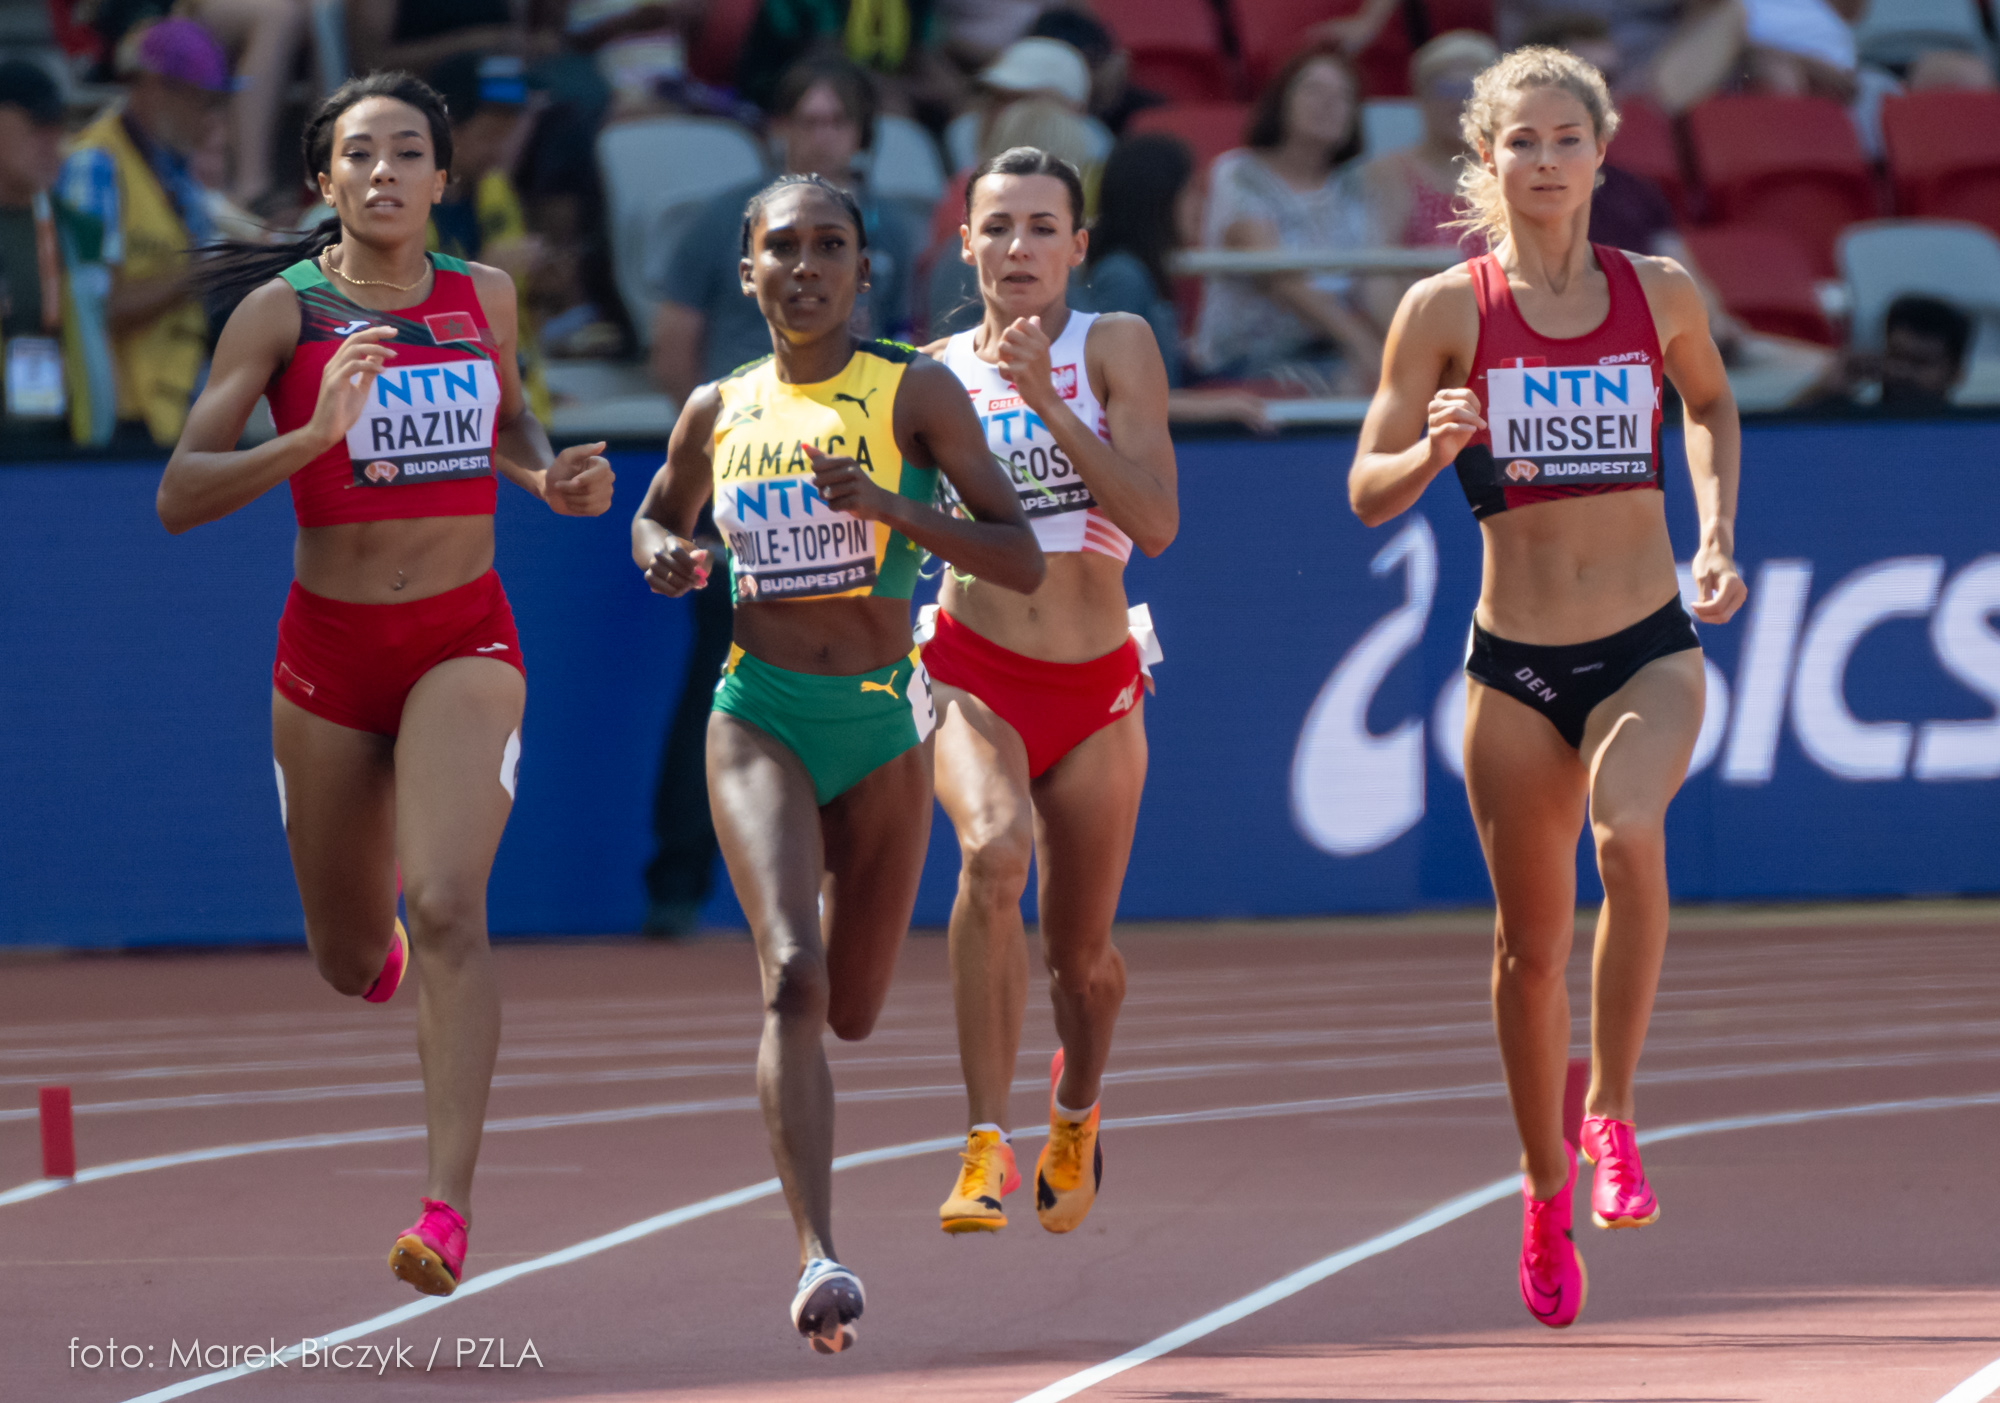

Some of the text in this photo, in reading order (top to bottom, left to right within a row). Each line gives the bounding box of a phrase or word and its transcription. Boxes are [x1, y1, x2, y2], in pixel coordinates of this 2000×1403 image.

[1598, 351, 1641, 365] CRAFT
[377, 364, 479, 409] NTN
[1523, 368, 1629, 408] NTN
[371, 408, 483, 451] RAZIKI
[1508, 414, 1638, 453] NISSEN
[404, 456, 481, 475] BUDAPEST
[1544, 461, 1647, 476] BUDAPEST 23
[1070, 488, 1091, 503] 23
[761, 566, 866, 593] BUDAPEST 23
[1514, 667, 1558, 702] DEN
